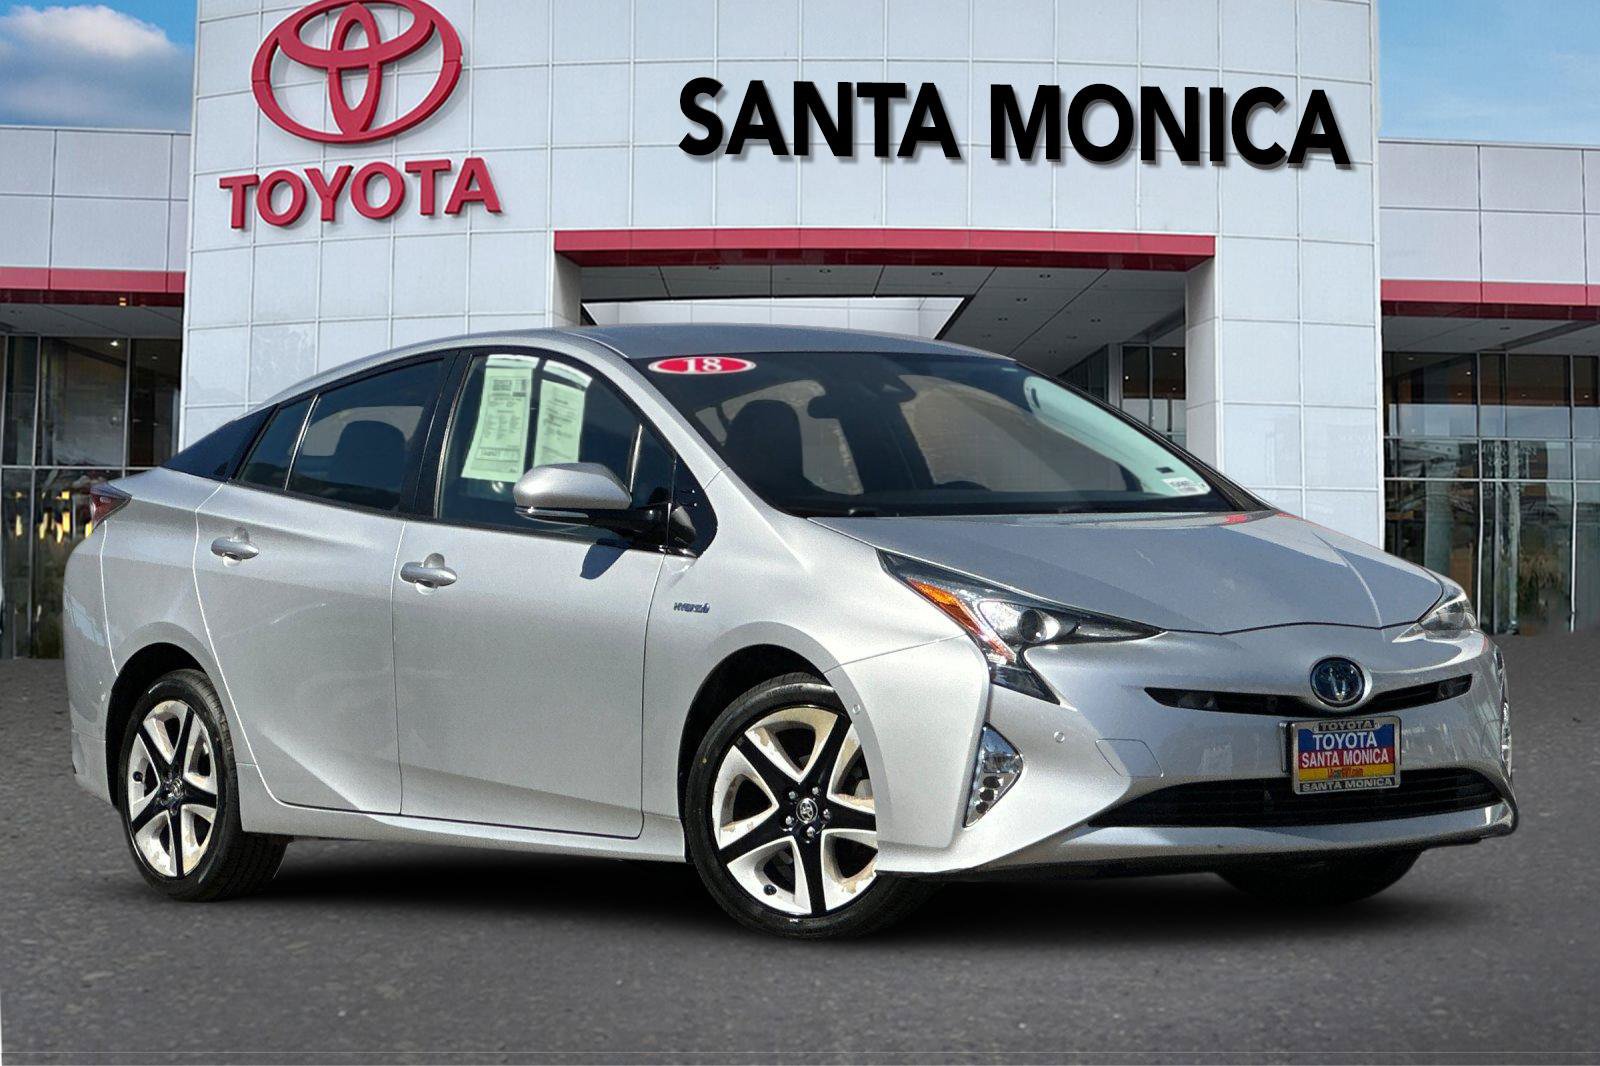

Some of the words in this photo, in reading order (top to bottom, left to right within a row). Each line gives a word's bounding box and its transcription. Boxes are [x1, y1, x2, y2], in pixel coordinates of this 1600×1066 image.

[678, 77, 961, 160] SANTA
[990, 83, 1352, 170] MONICA
[219, 157, 502, 229] TOYOTA
[682, 357, 723, 375] 18
[1320, 721, 1373, 731] TOYOTA
[1312, 731, 1378, 750] TOYOTA
[1302, 751, 1340, 768] SANTA
[1343, 748, 1389, 766] MONICA
[1302, 781, 1342, 792] SANTA
[1344, 778, 1392, 790] MONICA
